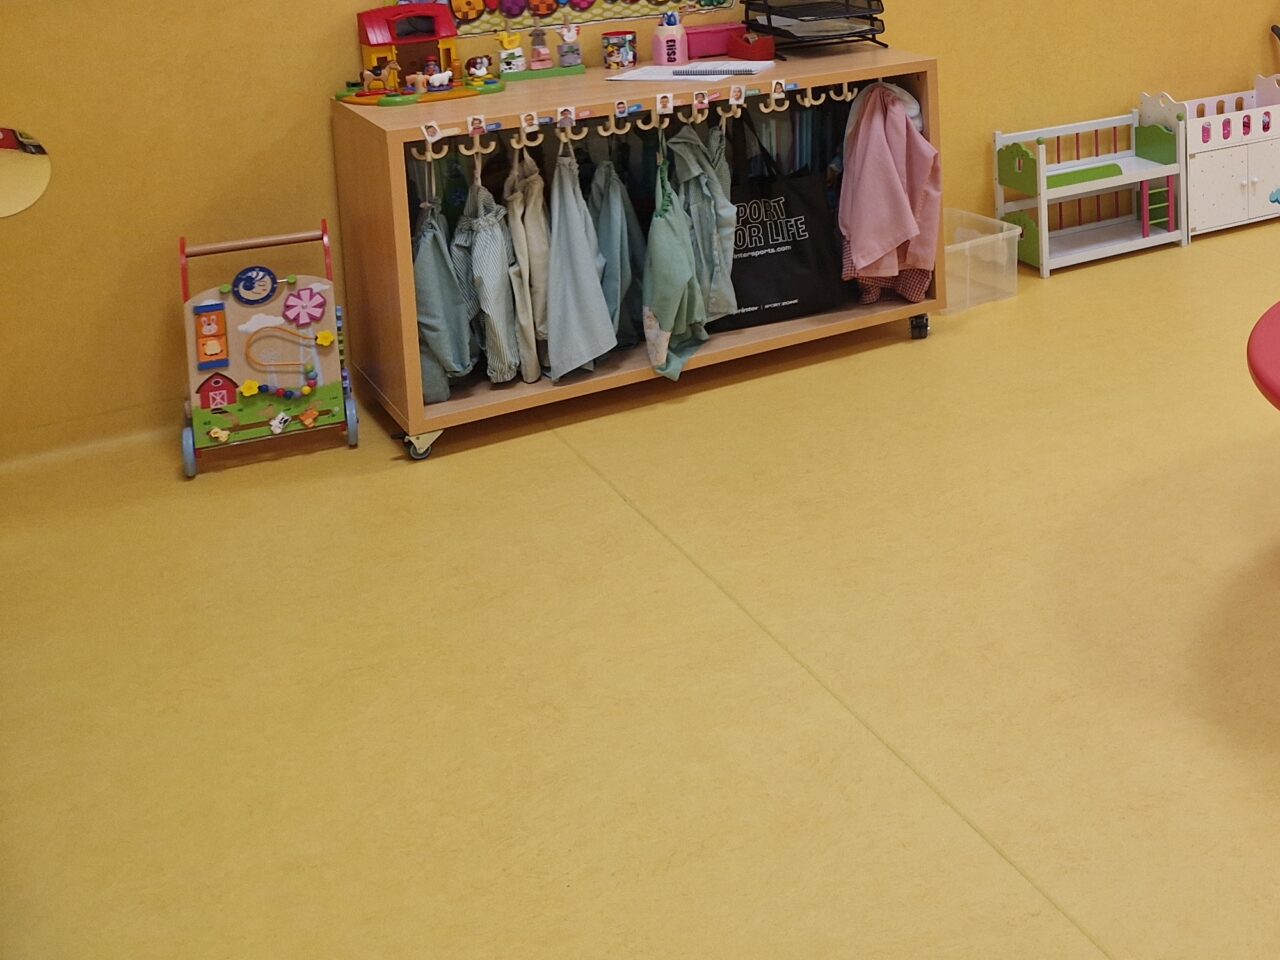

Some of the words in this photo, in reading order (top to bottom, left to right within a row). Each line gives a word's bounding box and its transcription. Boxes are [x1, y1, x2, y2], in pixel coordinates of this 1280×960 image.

[736, 196, 786, 226] PORT
[734, 223, 765, 250] OR
[767, 216, 809, 244] LIFE
[734, 245, 792, 259] intersports.com
